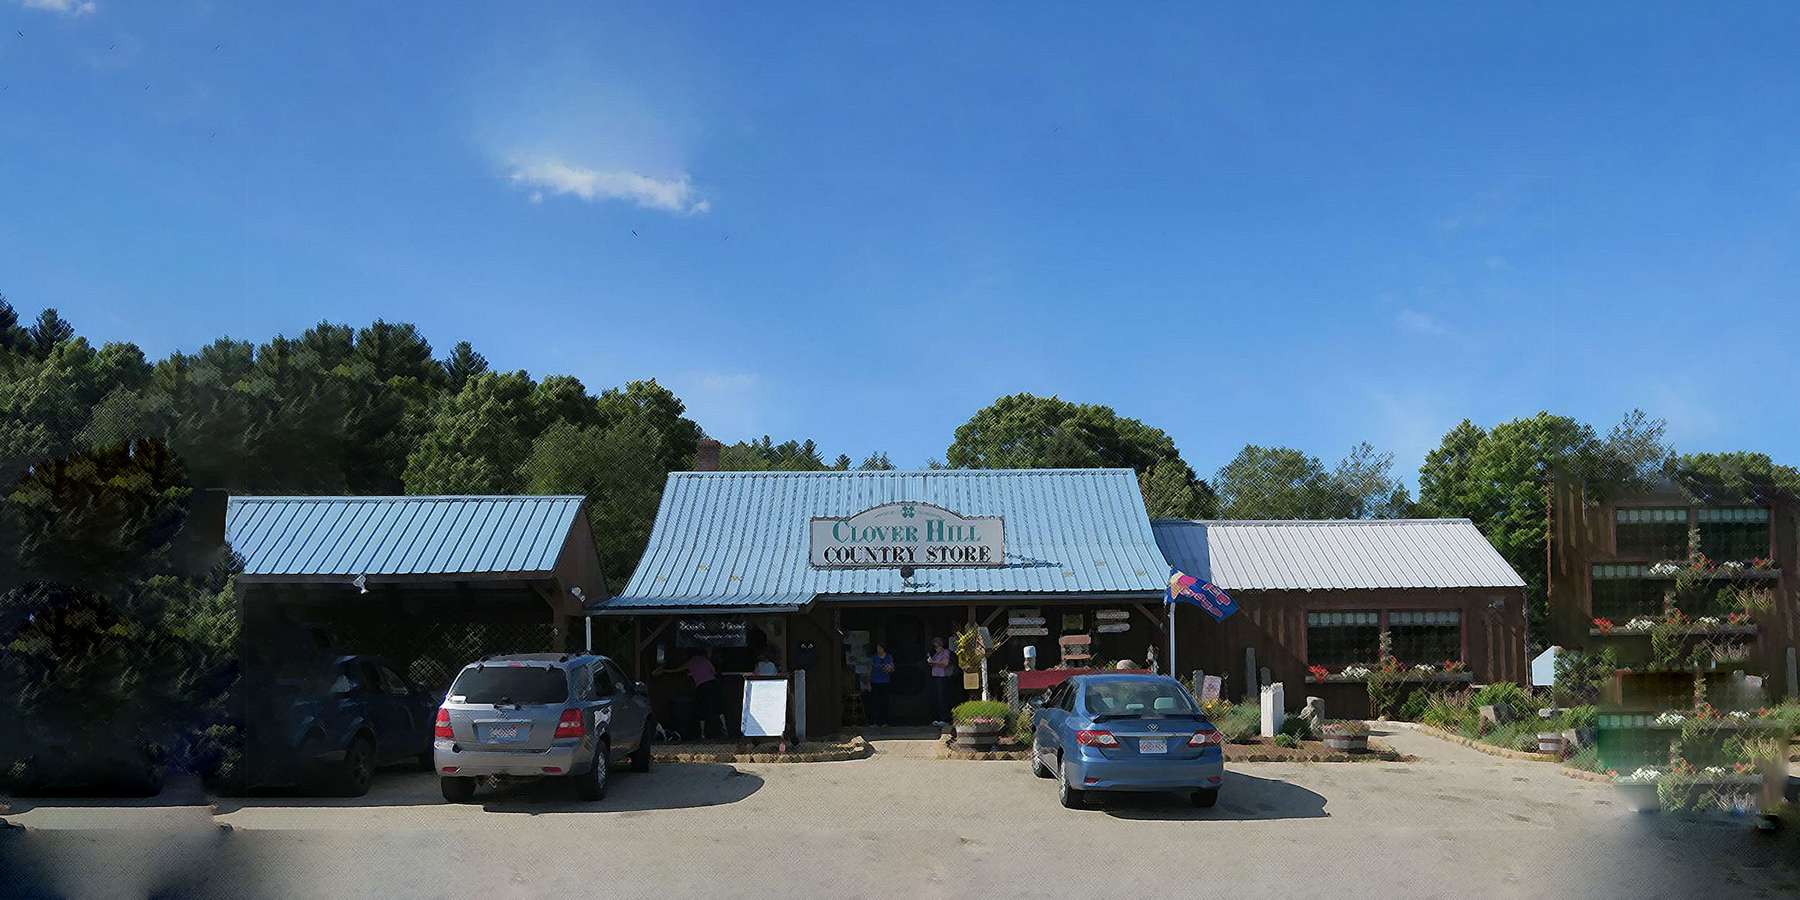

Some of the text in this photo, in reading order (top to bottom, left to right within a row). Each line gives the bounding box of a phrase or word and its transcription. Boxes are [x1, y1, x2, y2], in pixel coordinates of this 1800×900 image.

[832, 519, 981, 543] CLOVER HILL
[823, 545, 991, 563] COUNTRY STORE
